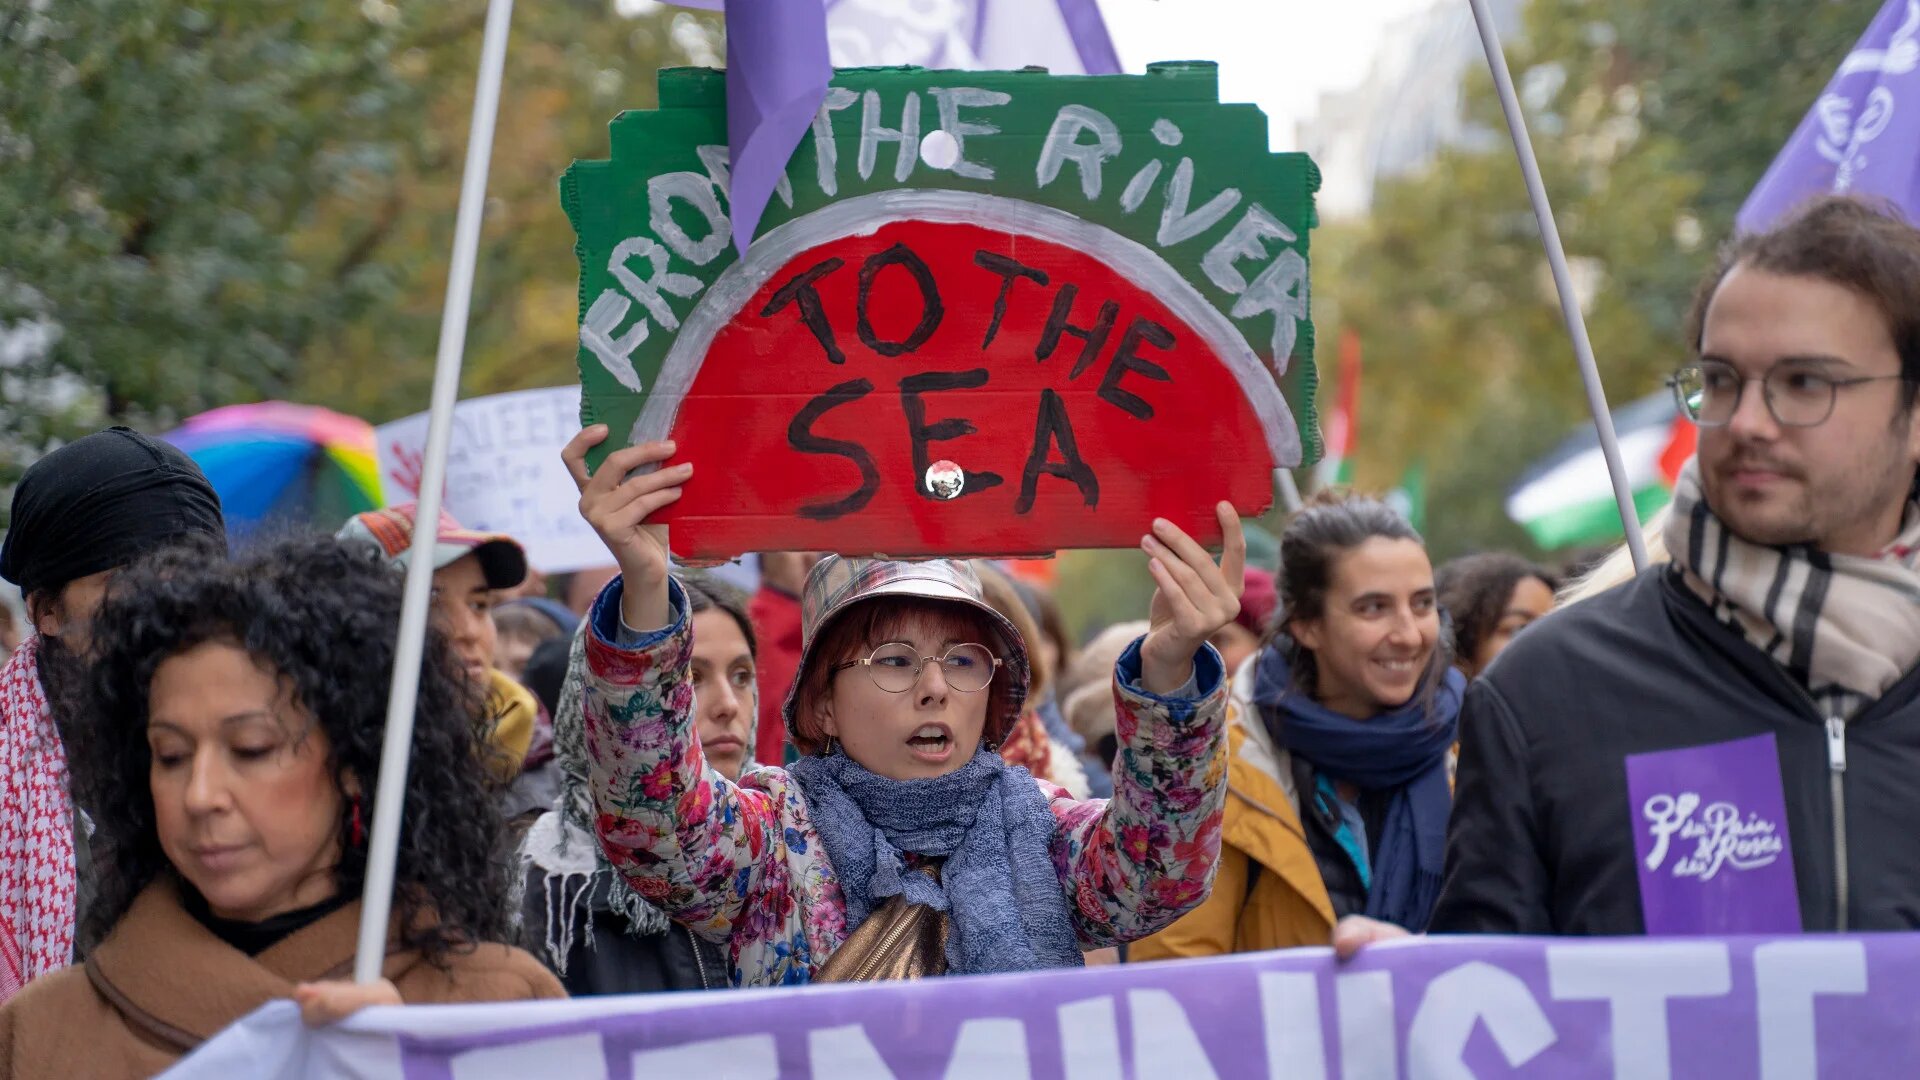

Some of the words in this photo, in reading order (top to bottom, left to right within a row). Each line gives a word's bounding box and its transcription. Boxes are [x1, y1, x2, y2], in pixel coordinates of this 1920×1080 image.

[812, 86, 1013, 197] THE
[760, 243, 945, 364] TO
[974, 249, 1177, 421] THE
[788, 367, 1099, 520] SEA
[1704, 802, 1776, 849] Pain
